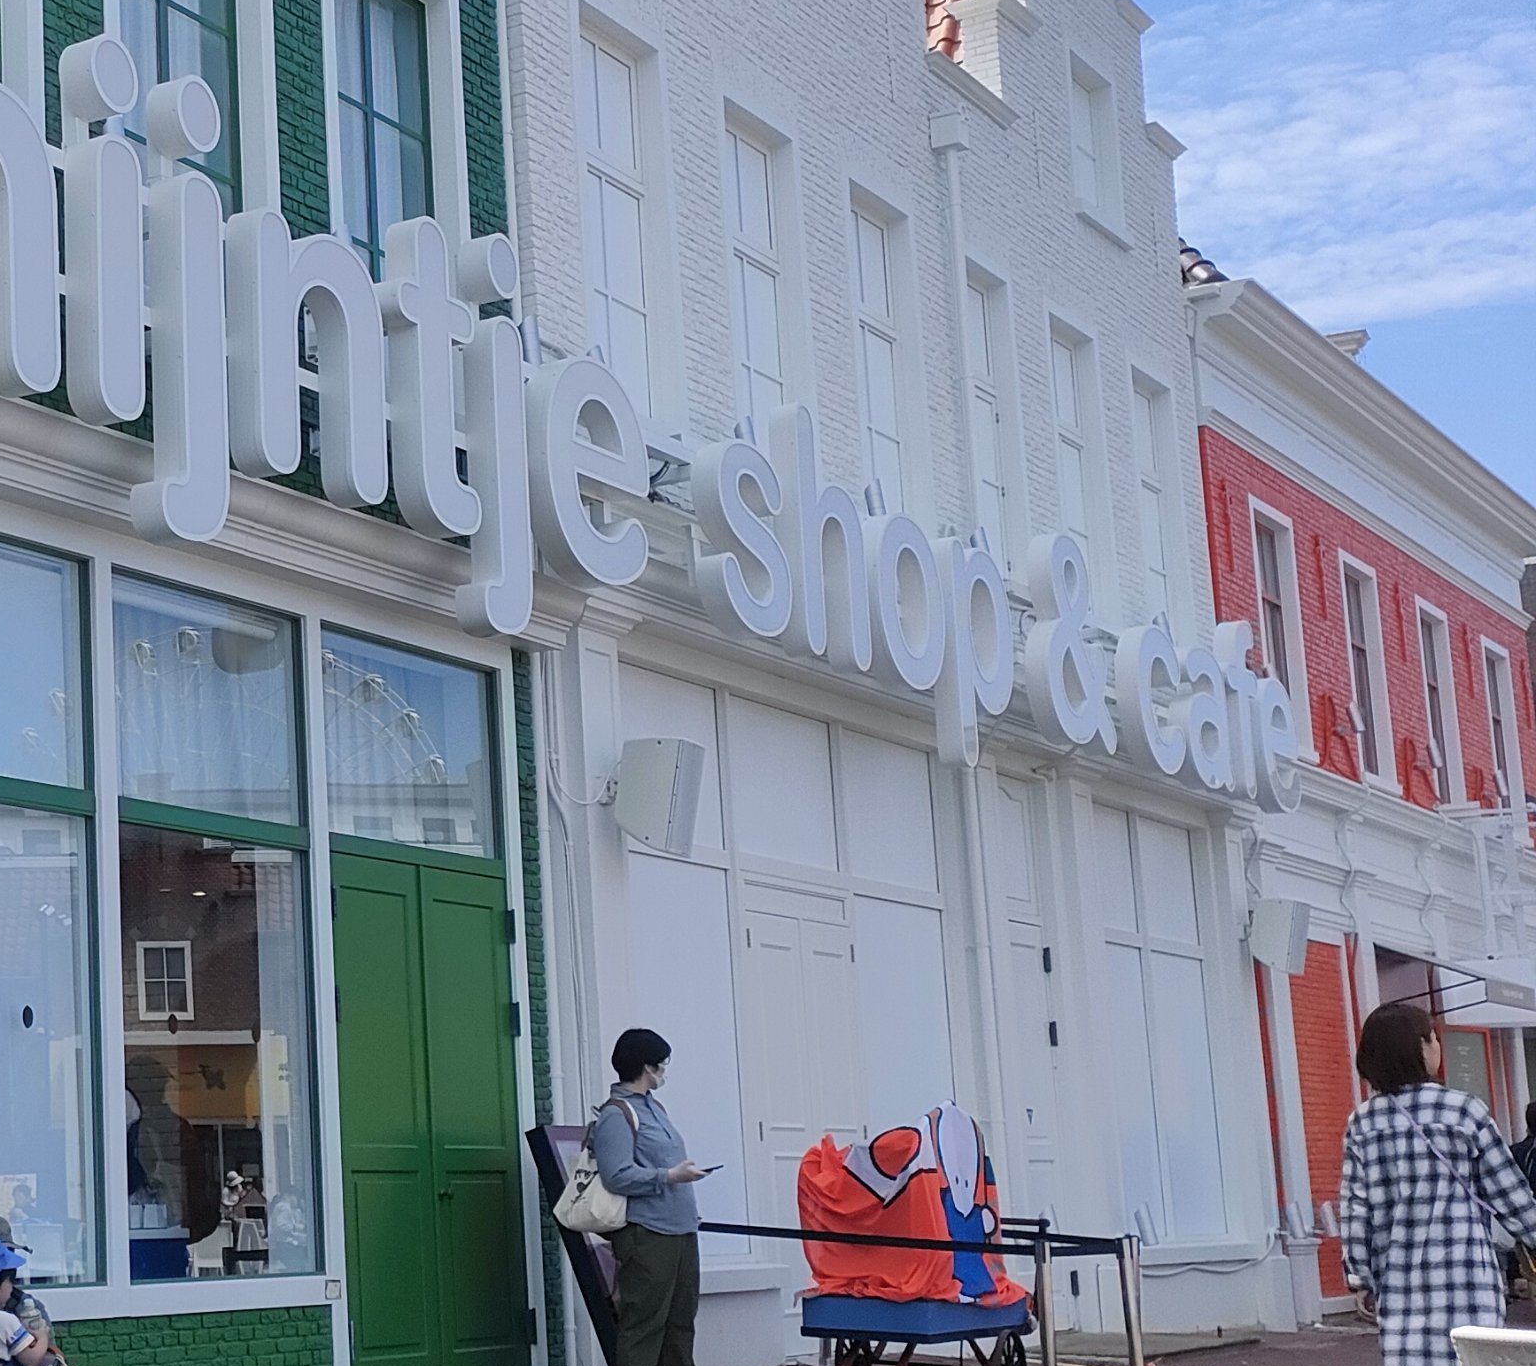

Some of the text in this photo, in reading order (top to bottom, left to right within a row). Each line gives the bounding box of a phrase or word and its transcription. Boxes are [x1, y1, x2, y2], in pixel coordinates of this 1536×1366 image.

[691, 403, 1013, 768] shop
[1025, 535, 1118, 756] &
[1116, 619, 1304, 815] cafe
